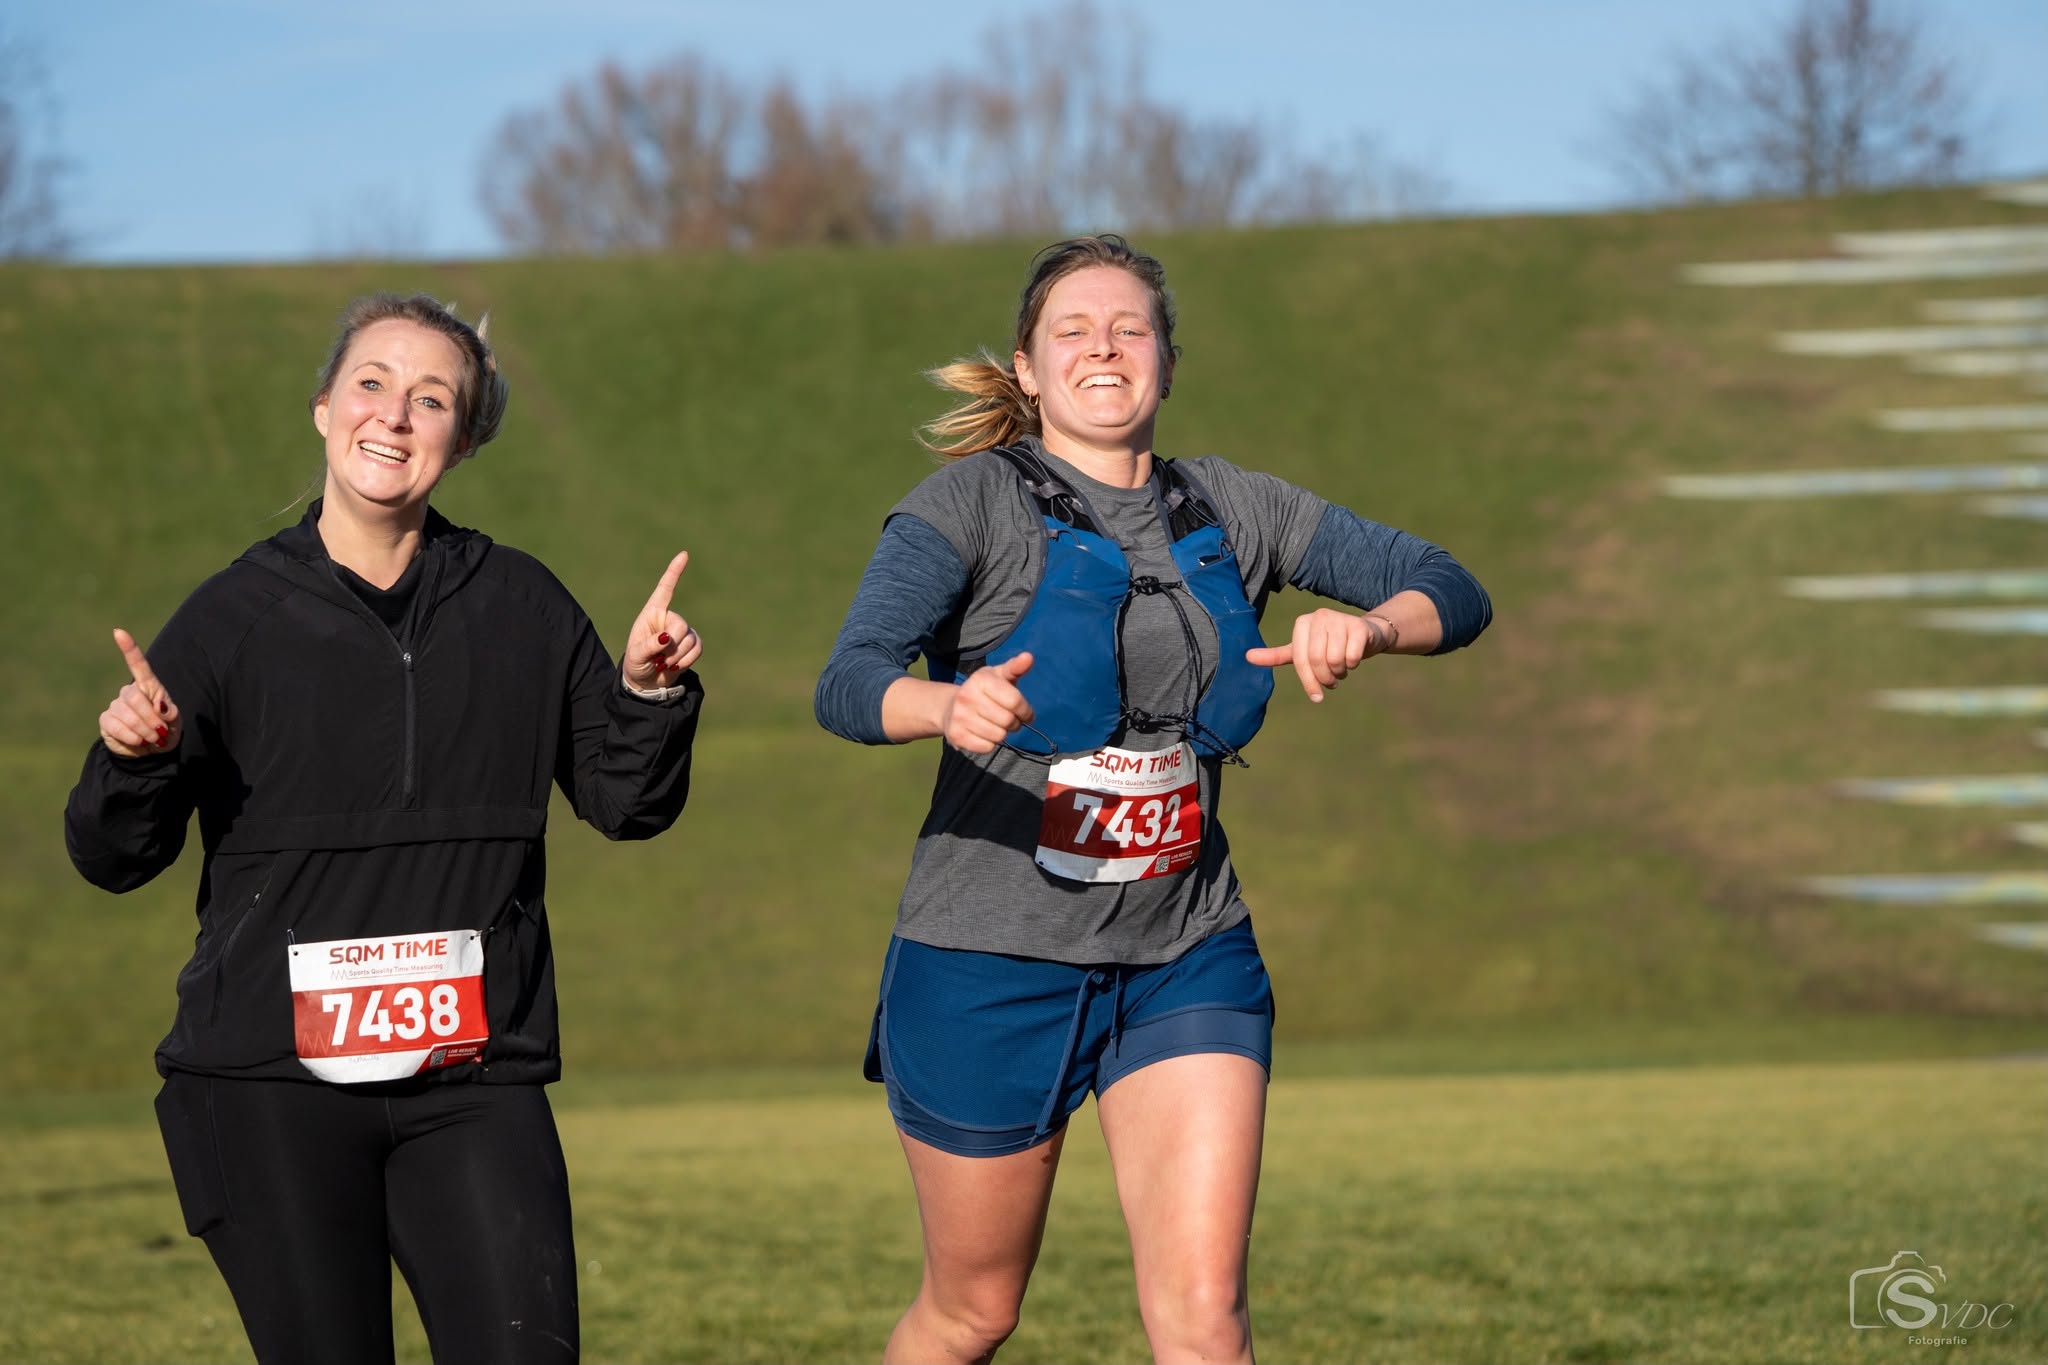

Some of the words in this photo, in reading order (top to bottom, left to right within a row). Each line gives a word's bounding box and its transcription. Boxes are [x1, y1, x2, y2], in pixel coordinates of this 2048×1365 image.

[1090, 751, 1143, 774] SQM
[1104, 777, 1124, 786] Sports
[1125, 779, 1145, 788] Quality
[1073, 792, 1183, 849] 7432
[328, 943, 384, 965] SQM
[348, 968, 370, 977] Sports
[370, 966, 393, 976] Quality
[394, 965, 410, 973] Time
[411, 962, 443, 972] Measuring
[321, 984, 460, 1046] 7438
